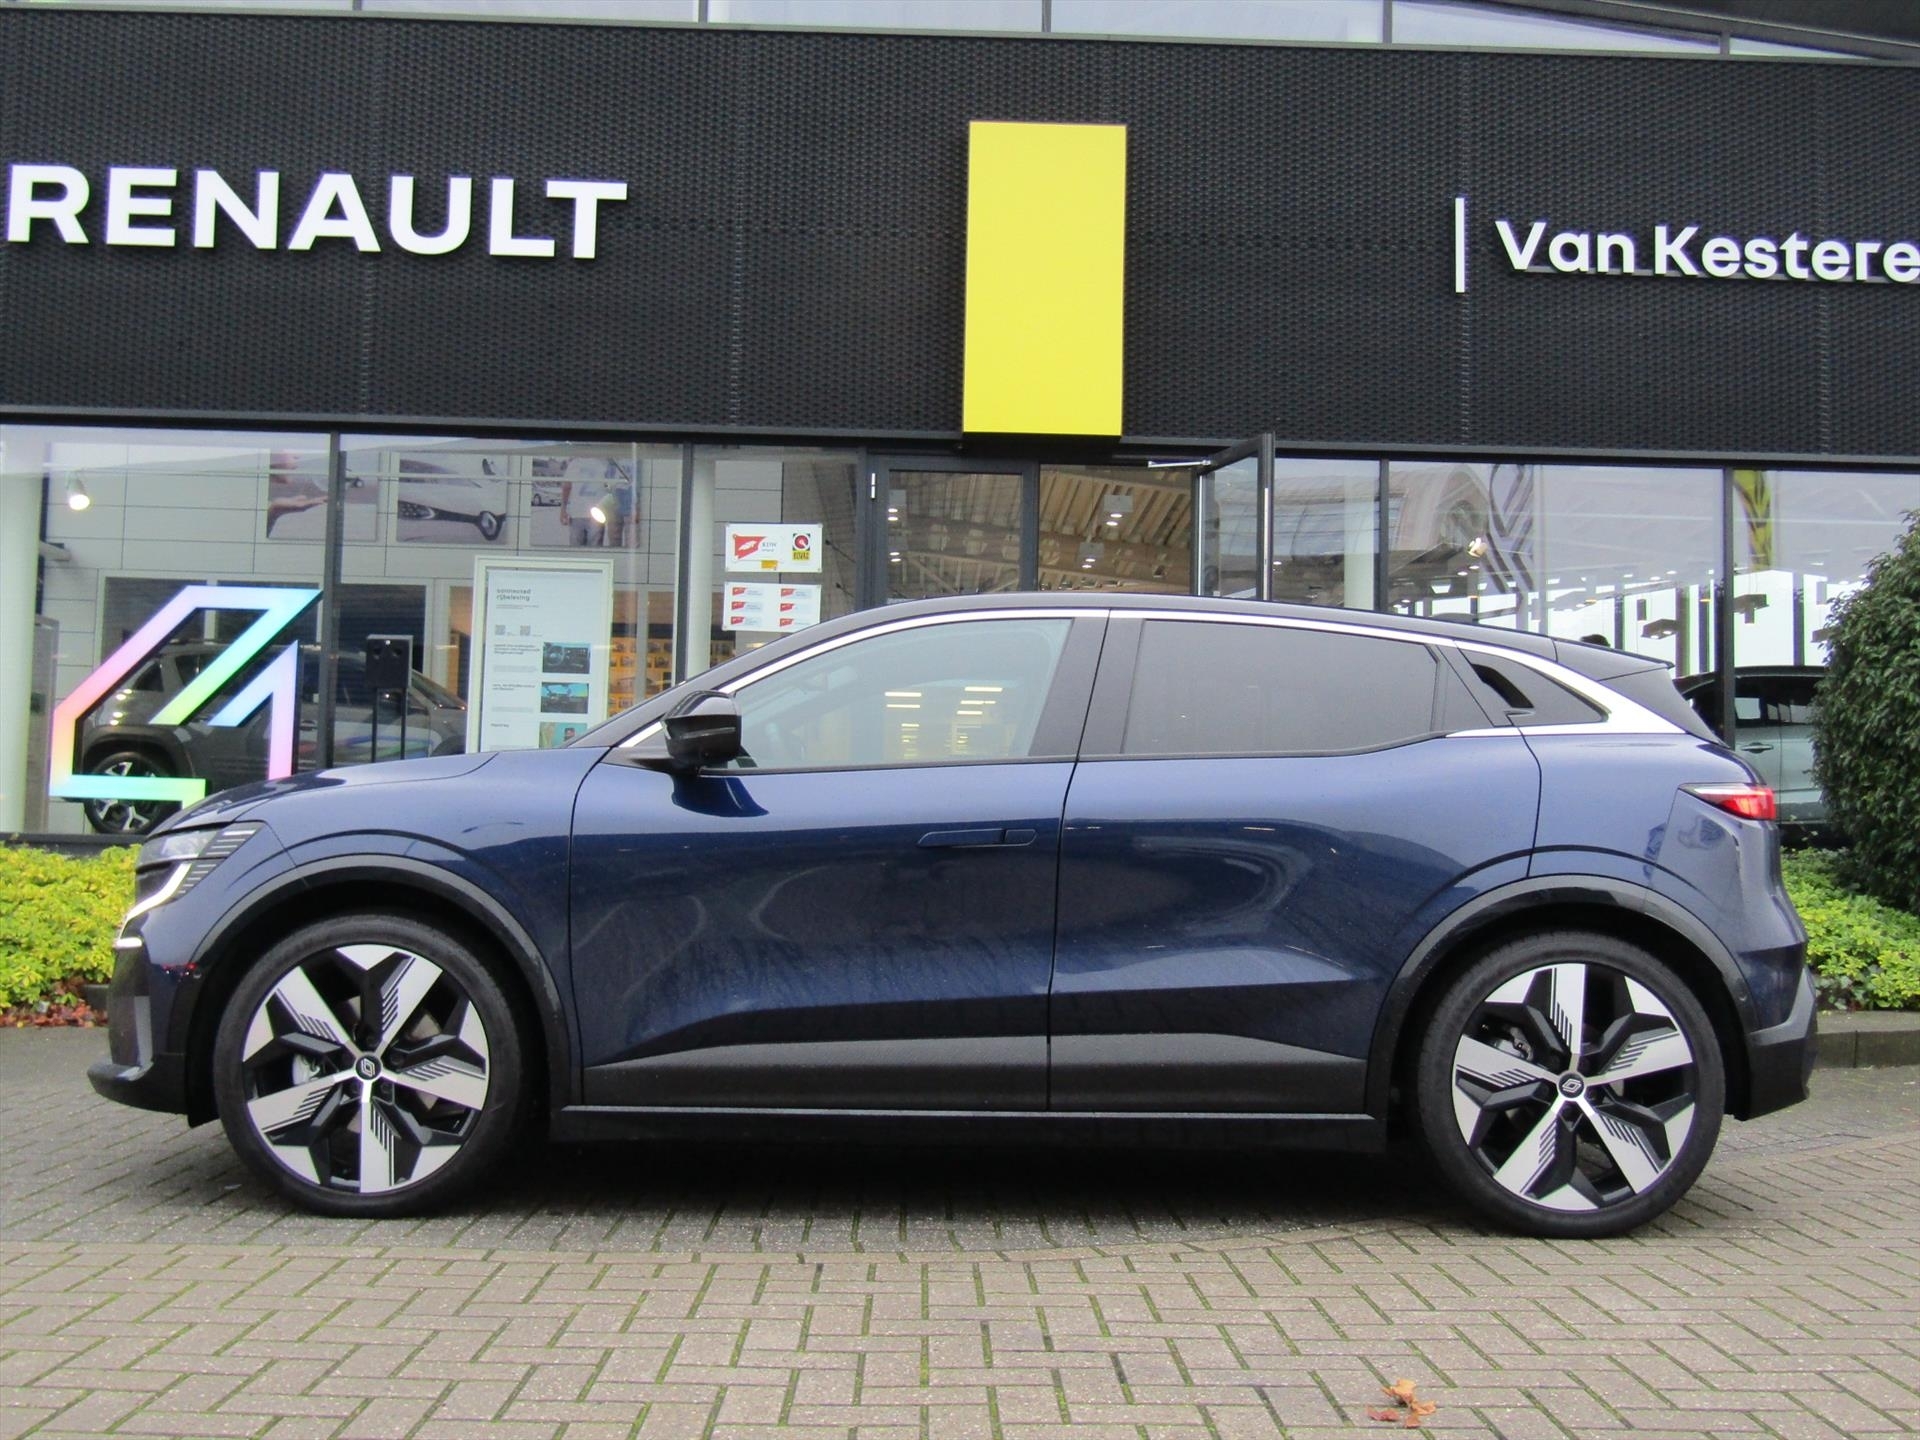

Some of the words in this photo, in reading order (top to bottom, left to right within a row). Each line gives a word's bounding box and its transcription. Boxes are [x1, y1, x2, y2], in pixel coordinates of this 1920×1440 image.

[7, 164, 628, 259] RENAULT
[1495, 220, 1635, 274] Van
[1655, 226, 1920, 283] Kestere
